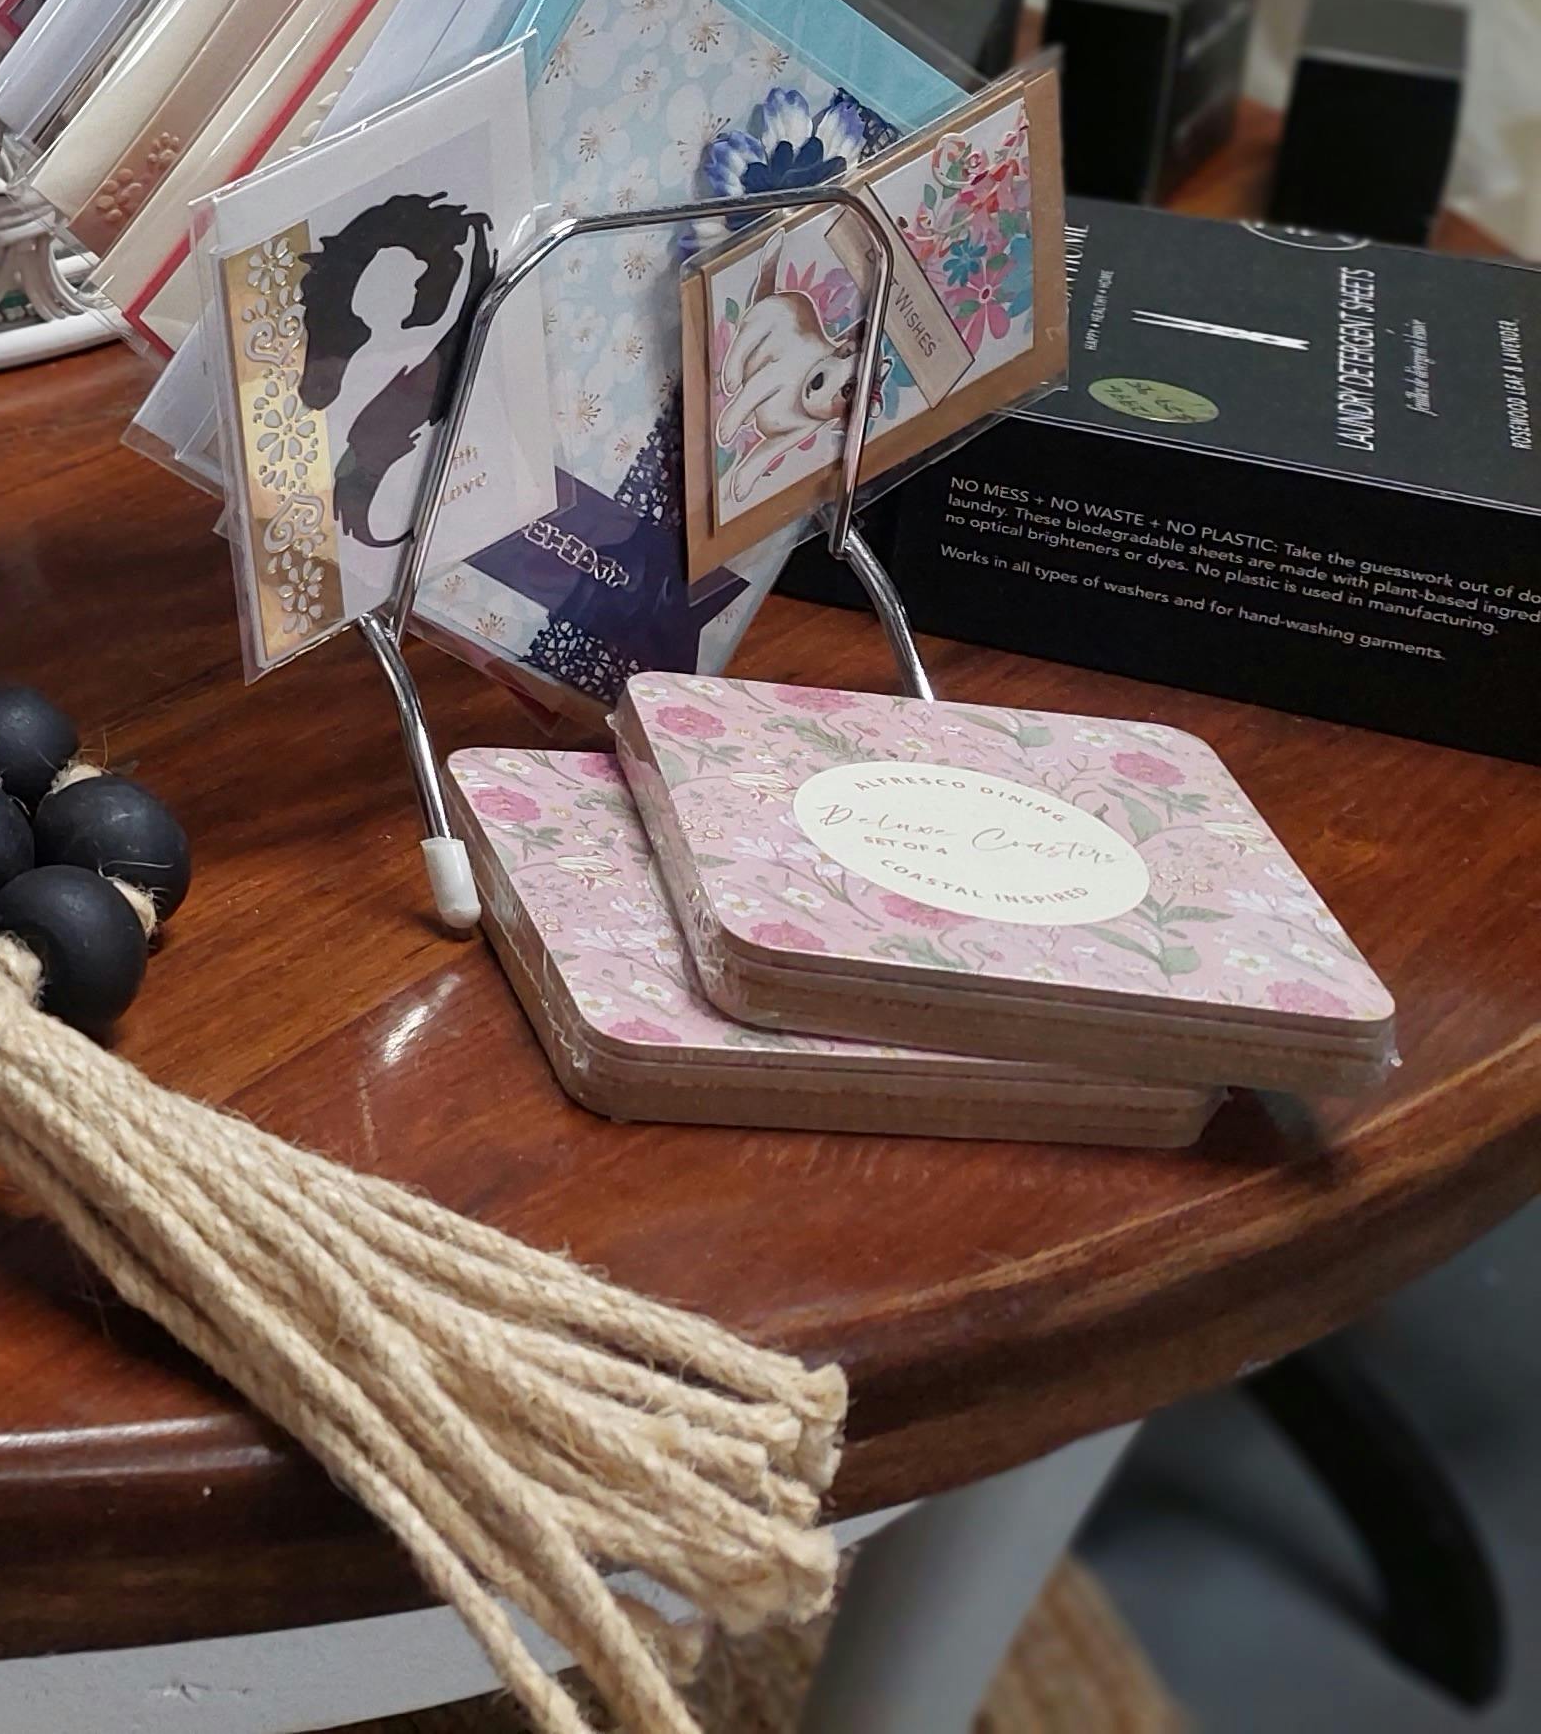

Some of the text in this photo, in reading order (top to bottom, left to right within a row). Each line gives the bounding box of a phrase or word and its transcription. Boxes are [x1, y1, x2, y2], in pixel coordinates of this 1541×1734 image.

[894, 286, 937, 358] WISHES
[1084, 269, 1115, 351] HAPPY HEALTHY HOME
[1495, 319, 1523, 364] LAVENDER
[1337, 266, 1376, 452] LAUNDRY DETERGENT SHEETS
[1501, 372, 1526, 396] LEAF
[1505, 396, 1533, 450] ROSEWOOD
[948, 493, 1009, 519] laundry.
[1015, 506, 1061, 528] These
[1066, 517, 1185, 553] biodegradable
[1189, 544, 1243, 565] sheets
[1248, 557, 1276, 570] are
[1280, 562, 1328, 581] made
[1332, 572, 1369, 589] with
[1373, 581, 1478, 611] plant-based
[951, 476, 978, 492] NO
[983, 483, 1030, 503] MESS
[1034, 496, 1045, 506] +
[1051, 497, 1079, 513] NO
[1084, 503, 1145, 526] WASTE
[1149, 519, 1161, 529] +
[1167, 520, 1195, 536] NO
[1202, 527, 1278, 553] PLASTIC:
[1285, 543, 1322, 562] Take
[1328, 552, 1356, 568] the
[1360, 561, 1454, 588] guesswork
[1458, 579, 1489, 595] out
[1494, 585, 1514, 599] of
[940, 543, 1447, 661] Works in all types of washers and for hand-washing garments.
[945, 513, 1500, 636] no optical brighteners or dyes. No plastic is used in manufacturing.
[853, 774, 1068, 823] ALFRESCO DINING
[815, 803, 1119, 865] Deluxe Coasters
[863, 835, 898, 848] SET
[903, 840, 929, 852] OF
[880, 858, 1090, 906] COASTAL INSPIRED
